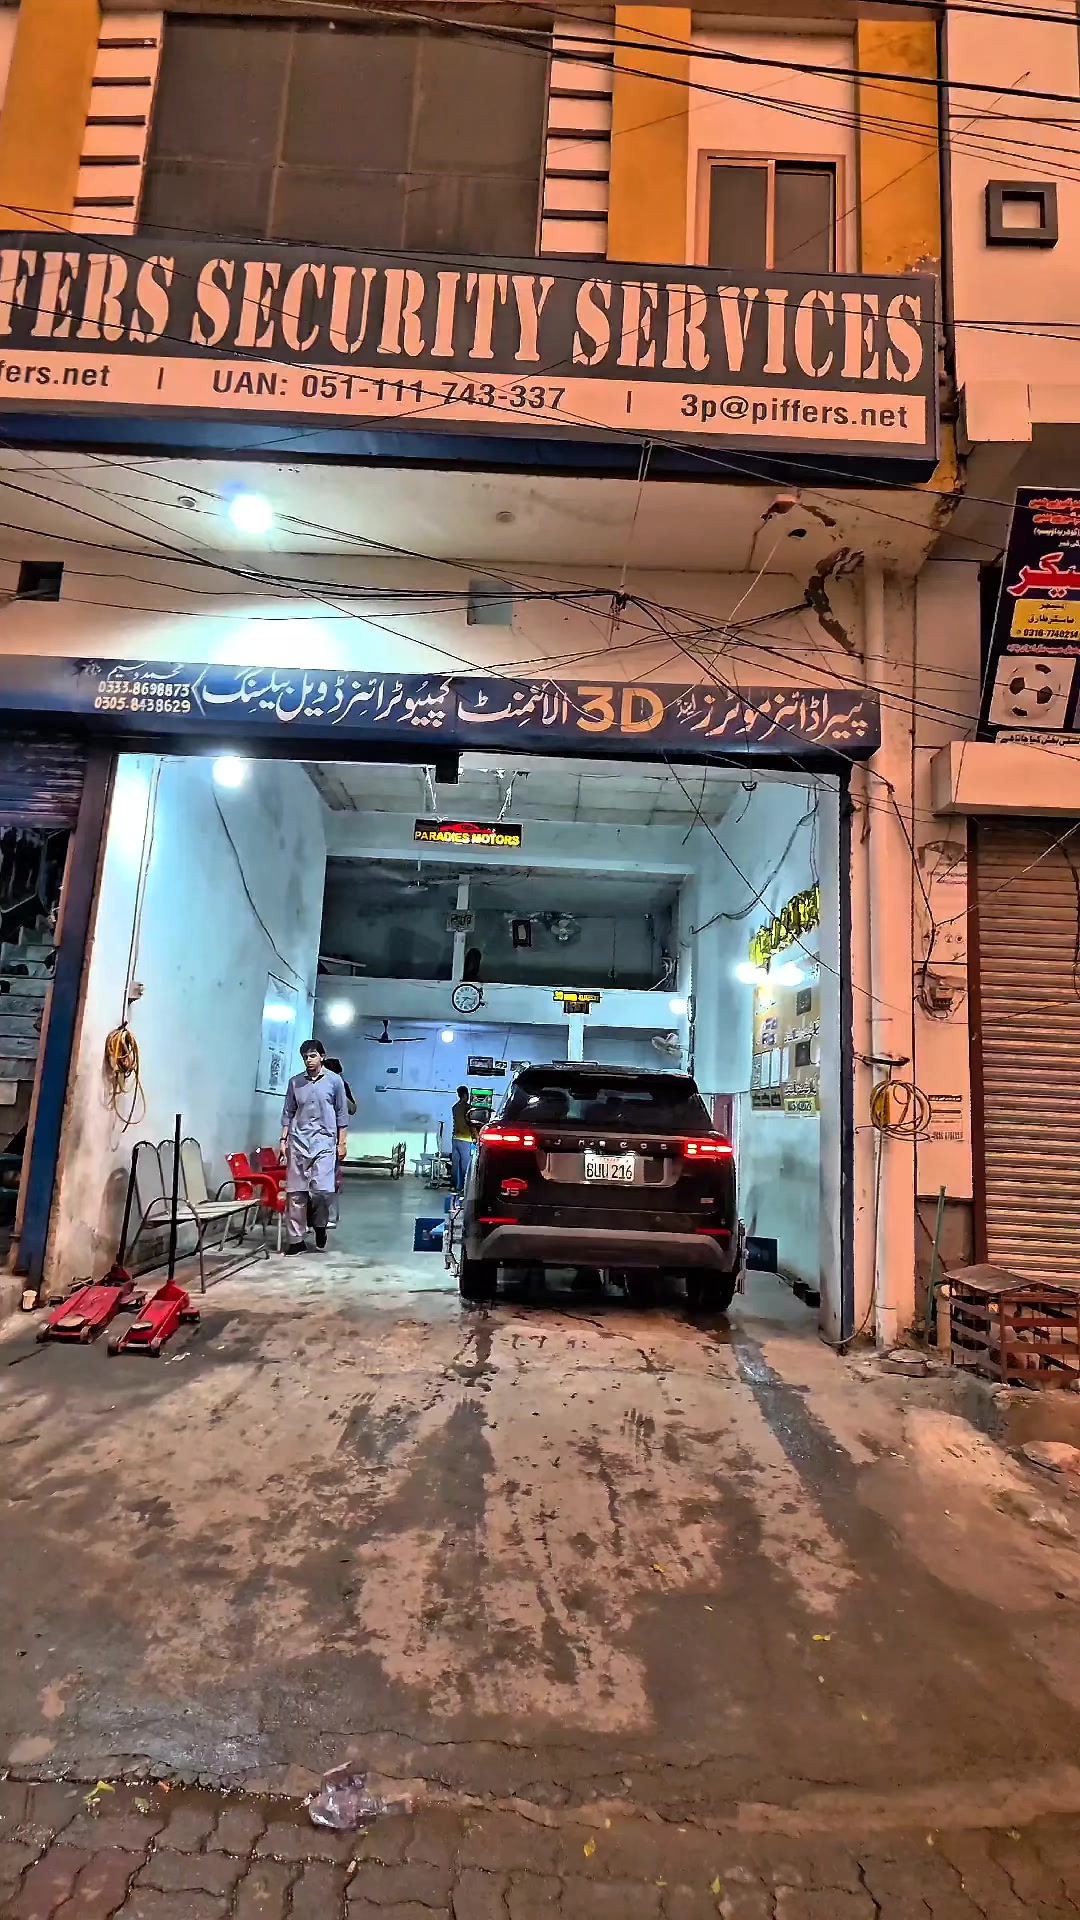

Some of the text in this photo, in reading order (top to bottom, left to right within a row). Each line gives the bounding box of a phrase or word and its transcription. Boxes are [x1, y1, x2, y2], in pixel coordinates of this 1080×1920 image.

[0, 250, 923, 382] FERS SECURITY SERVICES
[212, 369, 288, 397] UAN:
[680, 393, 908, 428] 3p@piffers.net
[576, 686, 664, 733] 3D
[471, 833, 520, 846] MOTORS
[611, 1165, 633, 1180] 216
